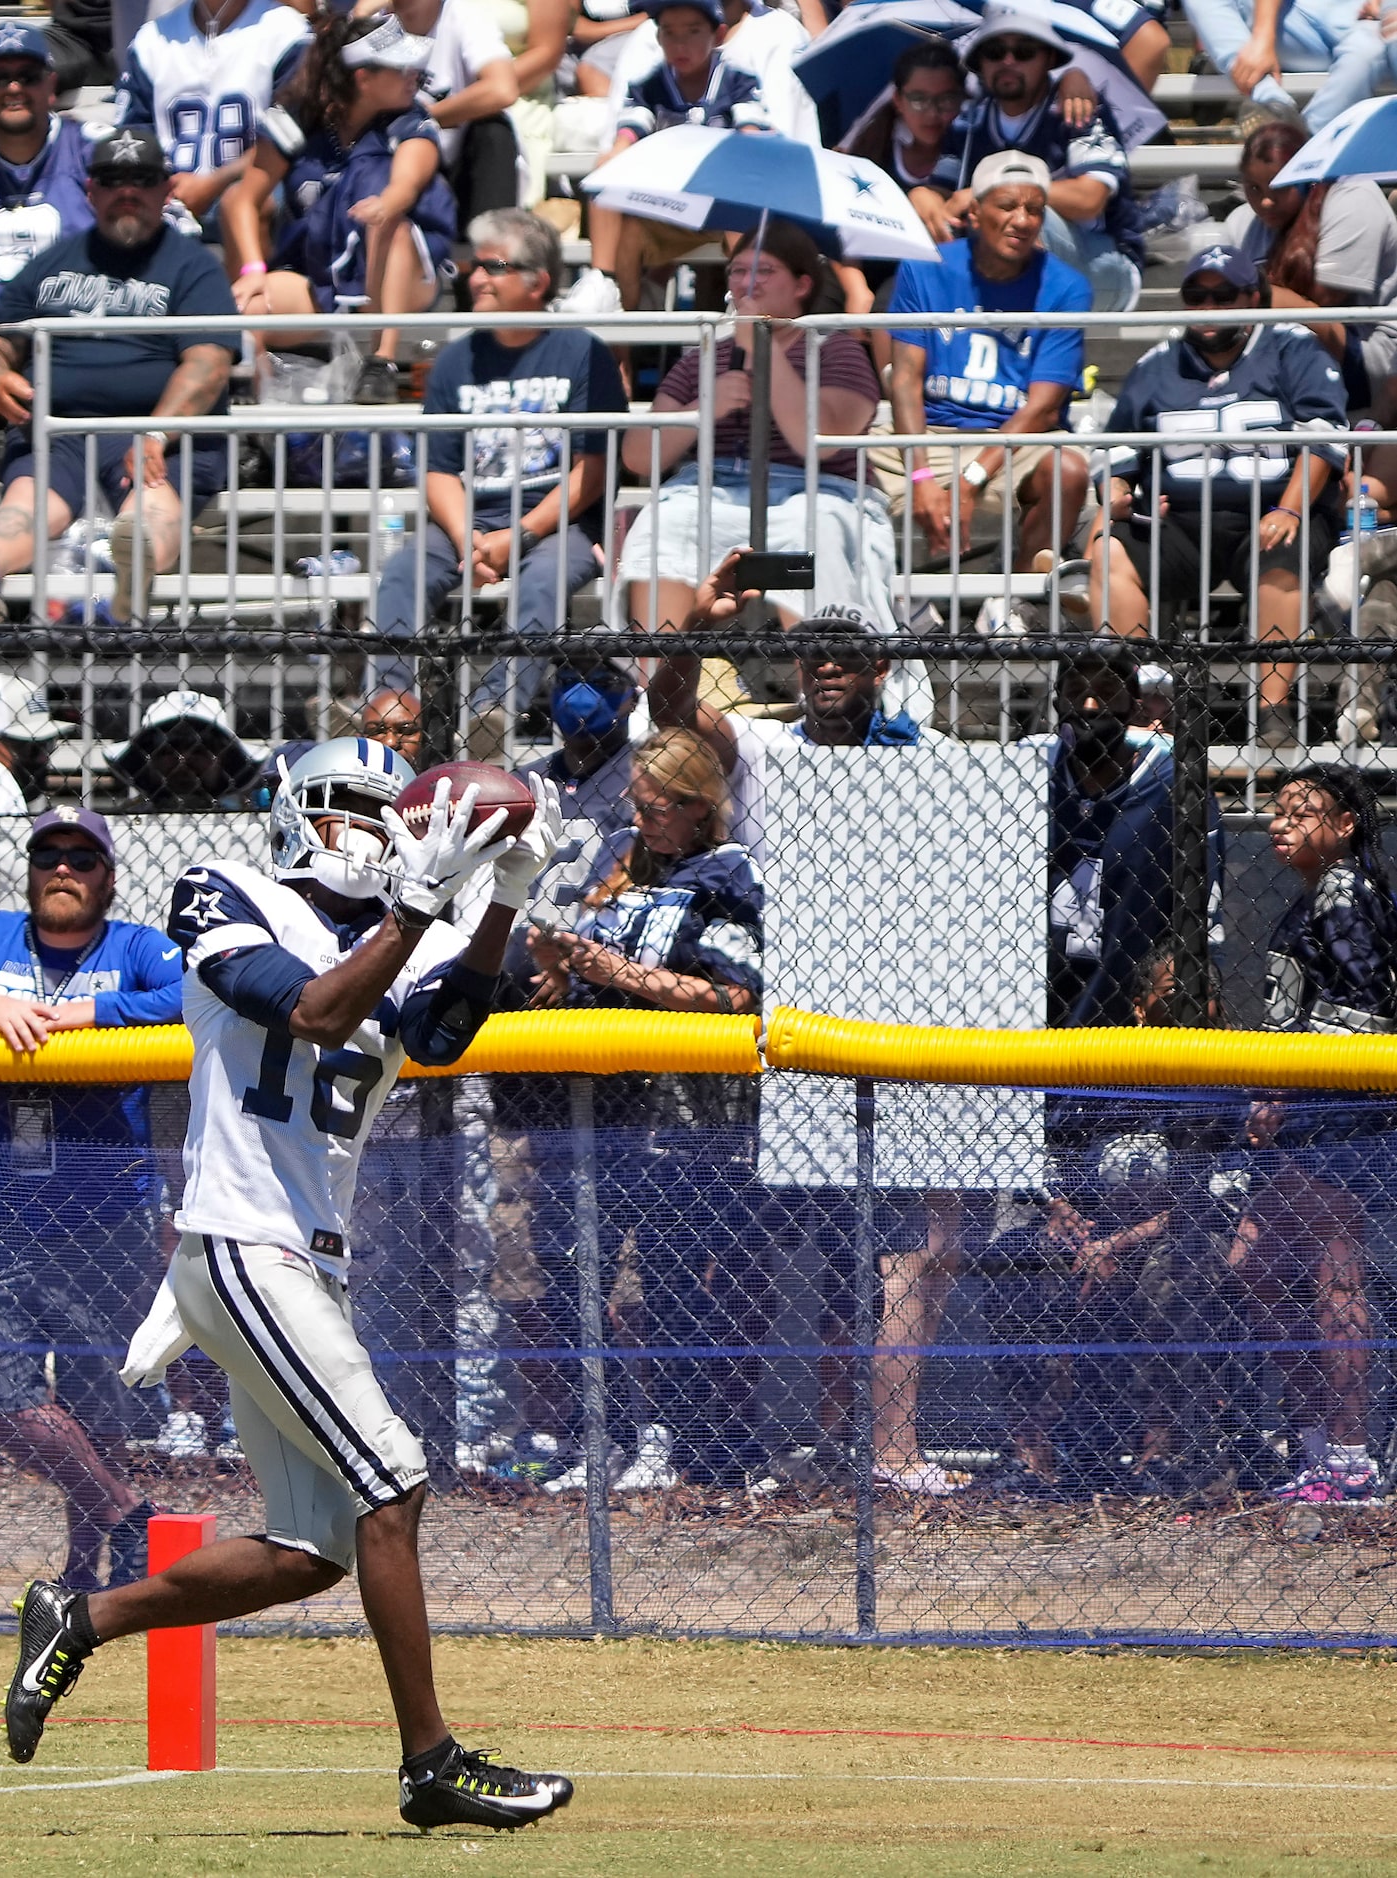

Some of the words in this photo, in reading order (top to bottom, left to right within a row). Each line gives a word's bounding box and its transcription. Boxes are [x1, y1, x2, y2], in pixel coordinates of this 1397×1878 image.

[166, 92, 256, 174] 88
[37, 271, 170, 317] COWBOYS
[1050, 857, 1105, 960] 4
